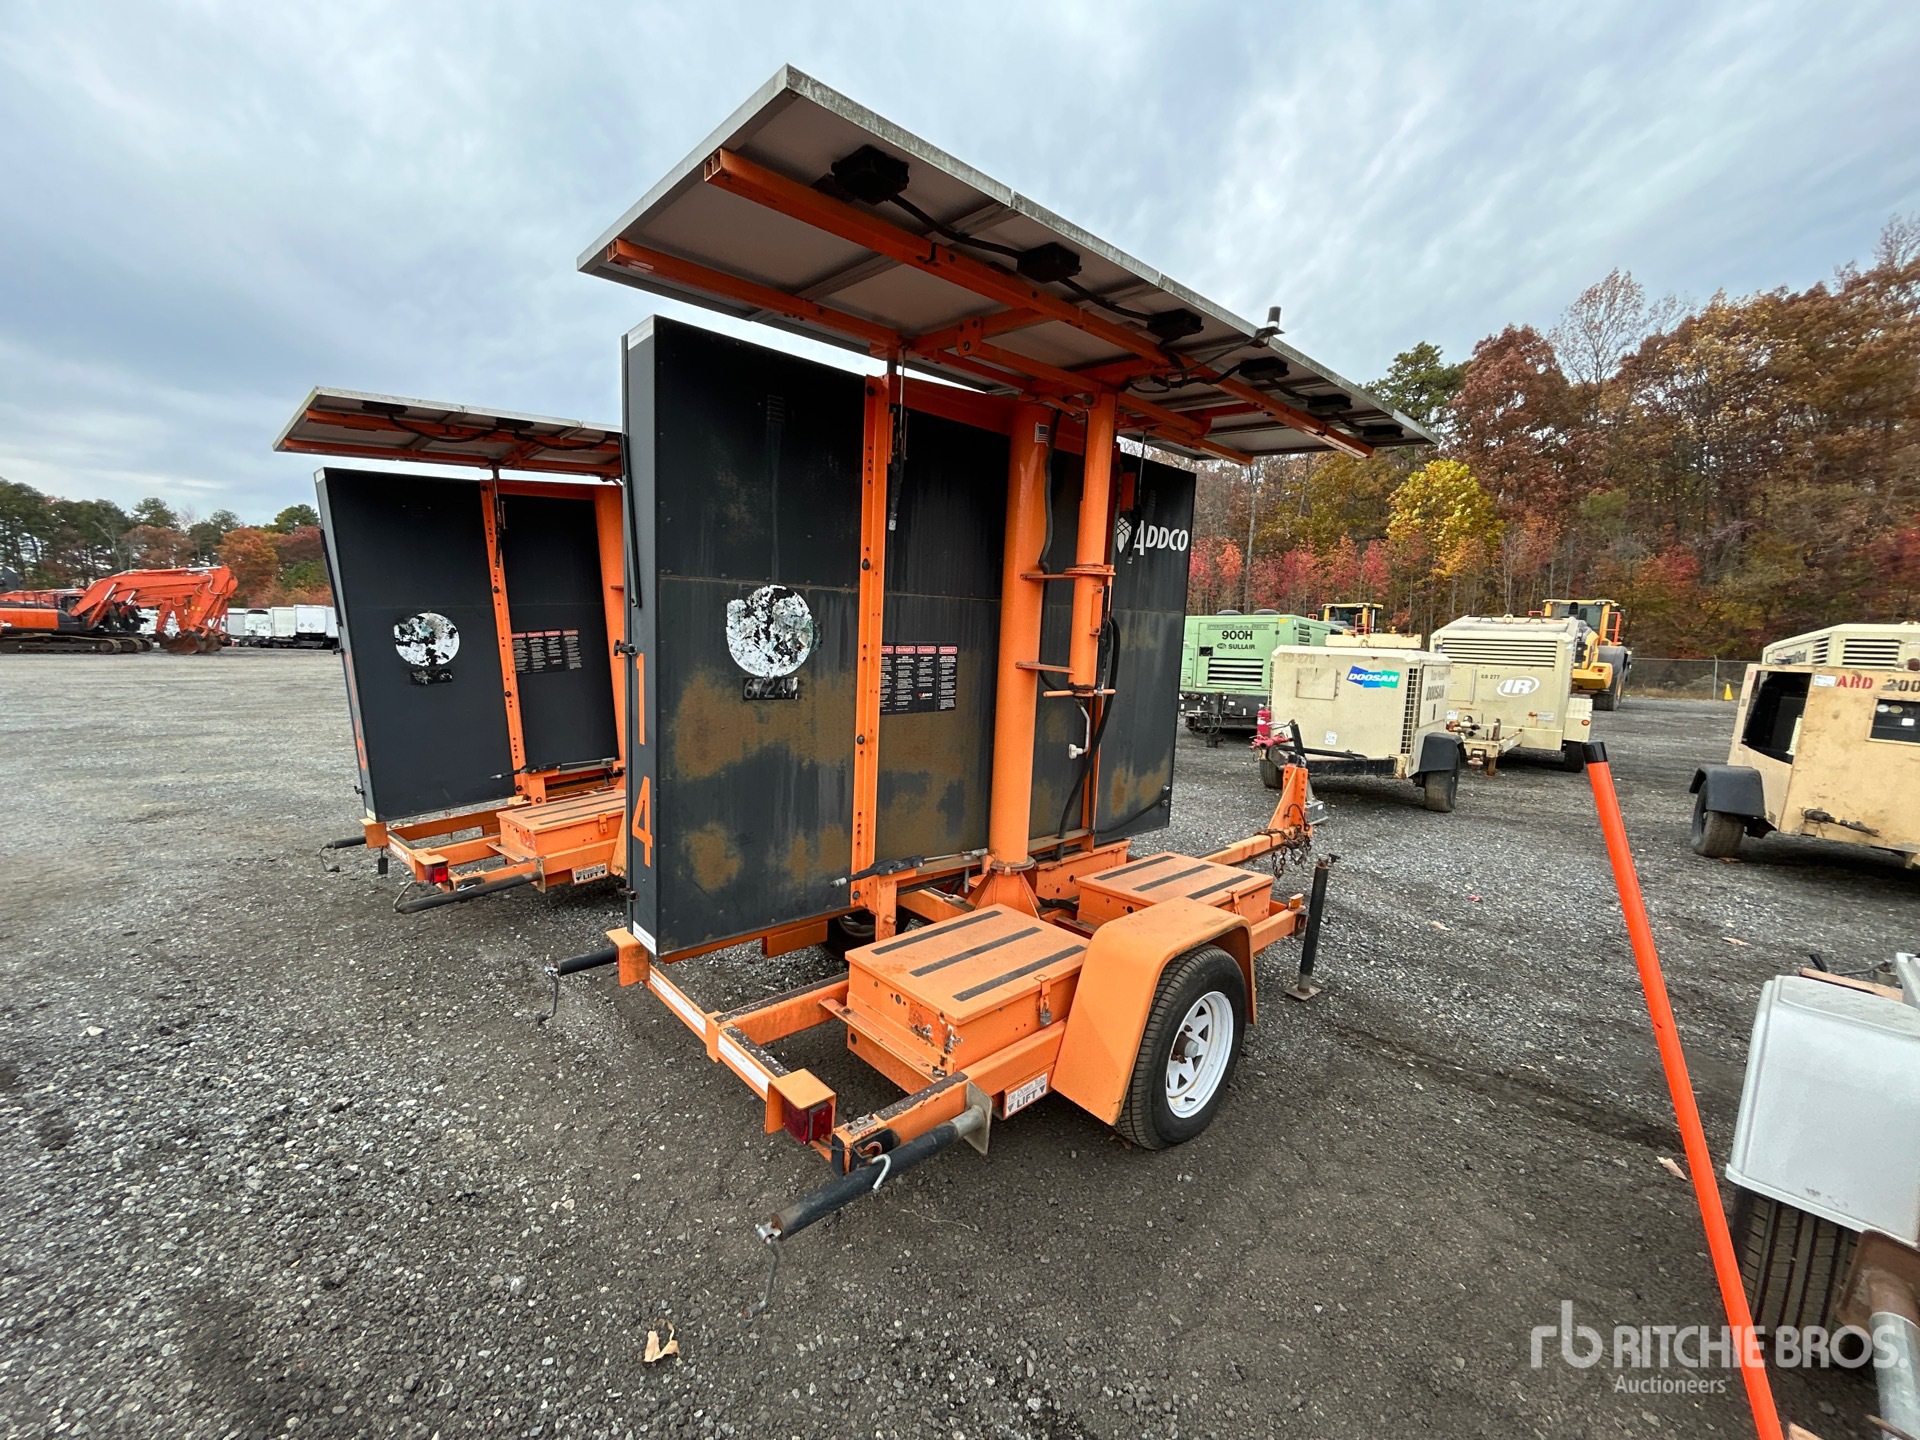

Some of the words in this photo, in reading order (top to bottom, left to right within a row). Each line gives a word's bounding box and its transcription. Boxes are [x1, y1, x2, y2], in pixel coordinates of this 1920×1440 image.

[1133, 520, 1188, 555] ADDCO
[1222, 630, 1253, 640] 900H
[1348, 673, 1399, 683] DOOSAN
[1836, 675, 1874, 689] ARD
[1502, 679, 1533, 694] IR
[1017, 1083, 1034, 1097] Down
[1016, 1090, 1037, 1109] LIFT
